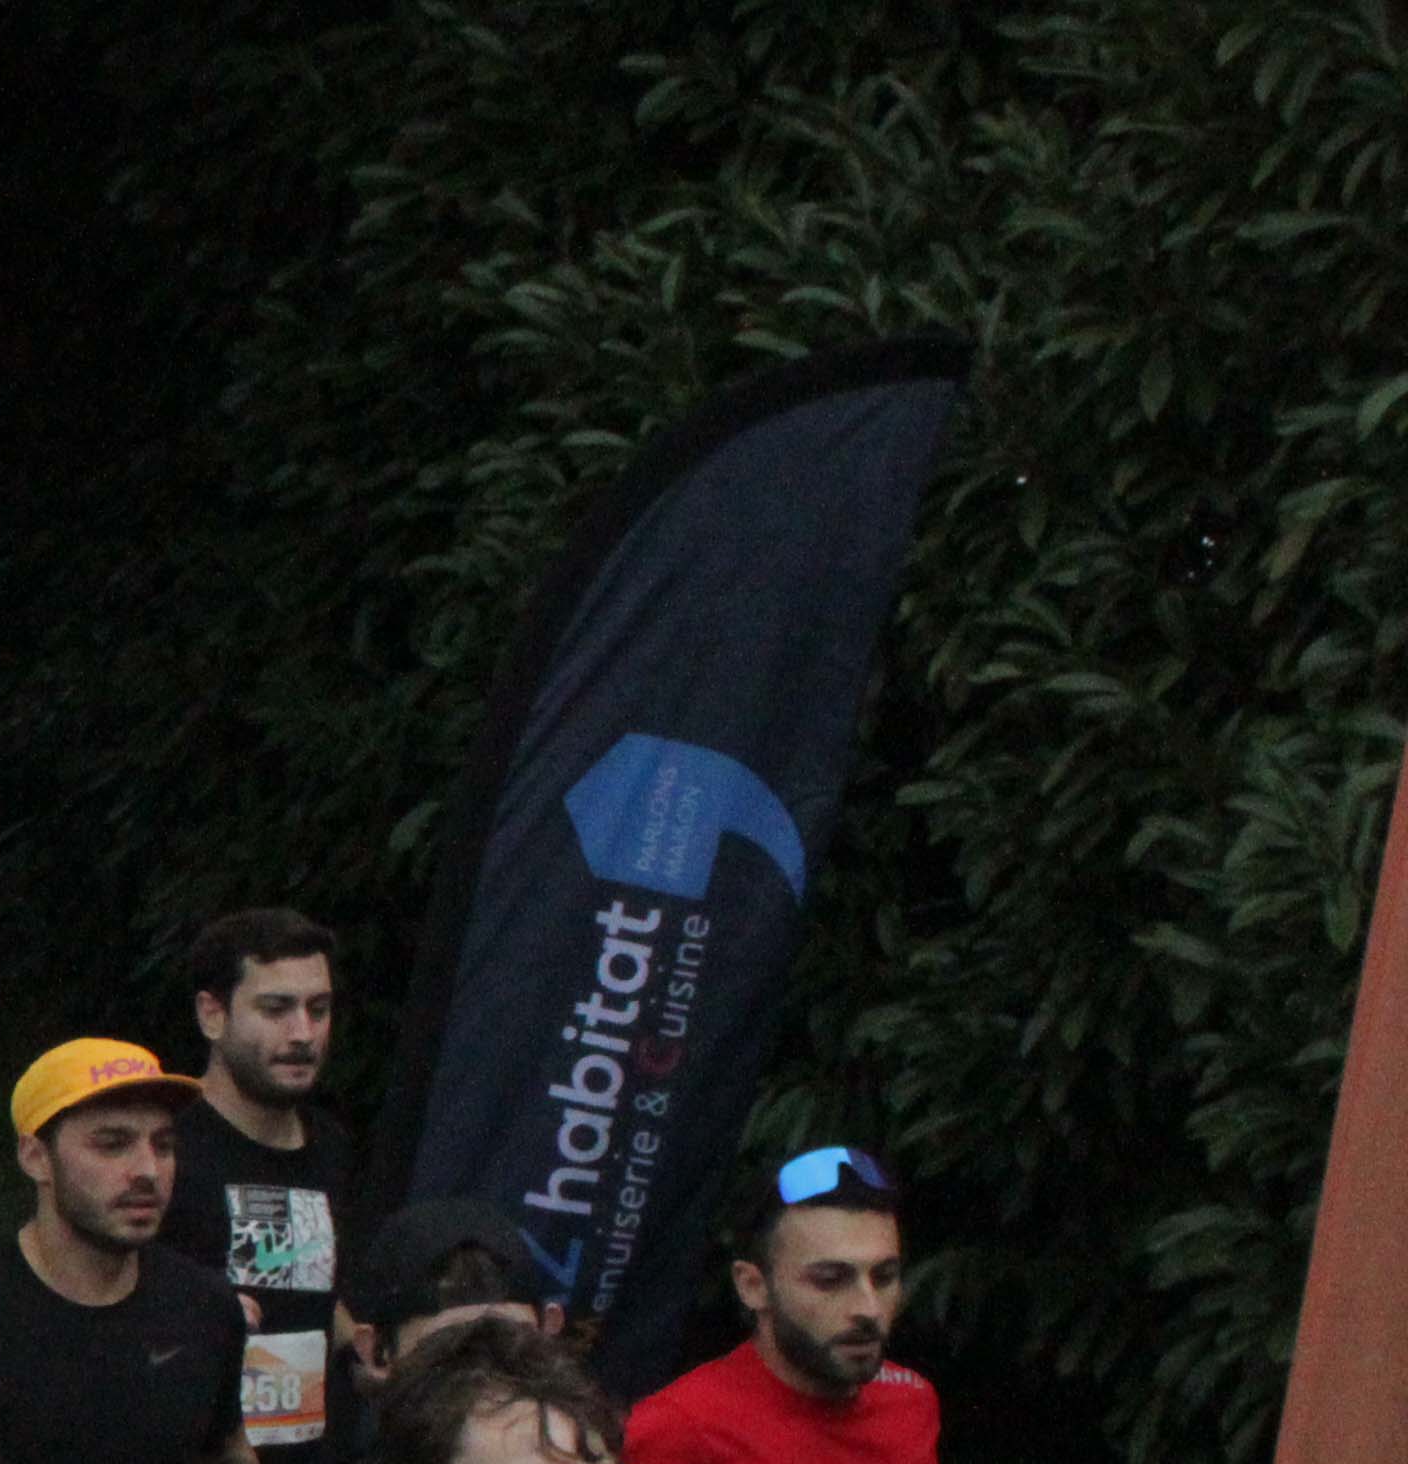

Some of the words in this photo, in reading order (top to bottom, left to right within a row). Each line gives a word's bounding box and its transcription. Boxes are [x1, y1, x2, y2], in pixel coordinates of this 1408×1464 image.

[524, 900, 663, 1218] habitat
[633, 912, 711, 1081] Cuisine
[635, 1091, 672, 1117] &
[520, 1226, 582, 1306] Z
[584, 1130, 661, 1318] enuiserie
